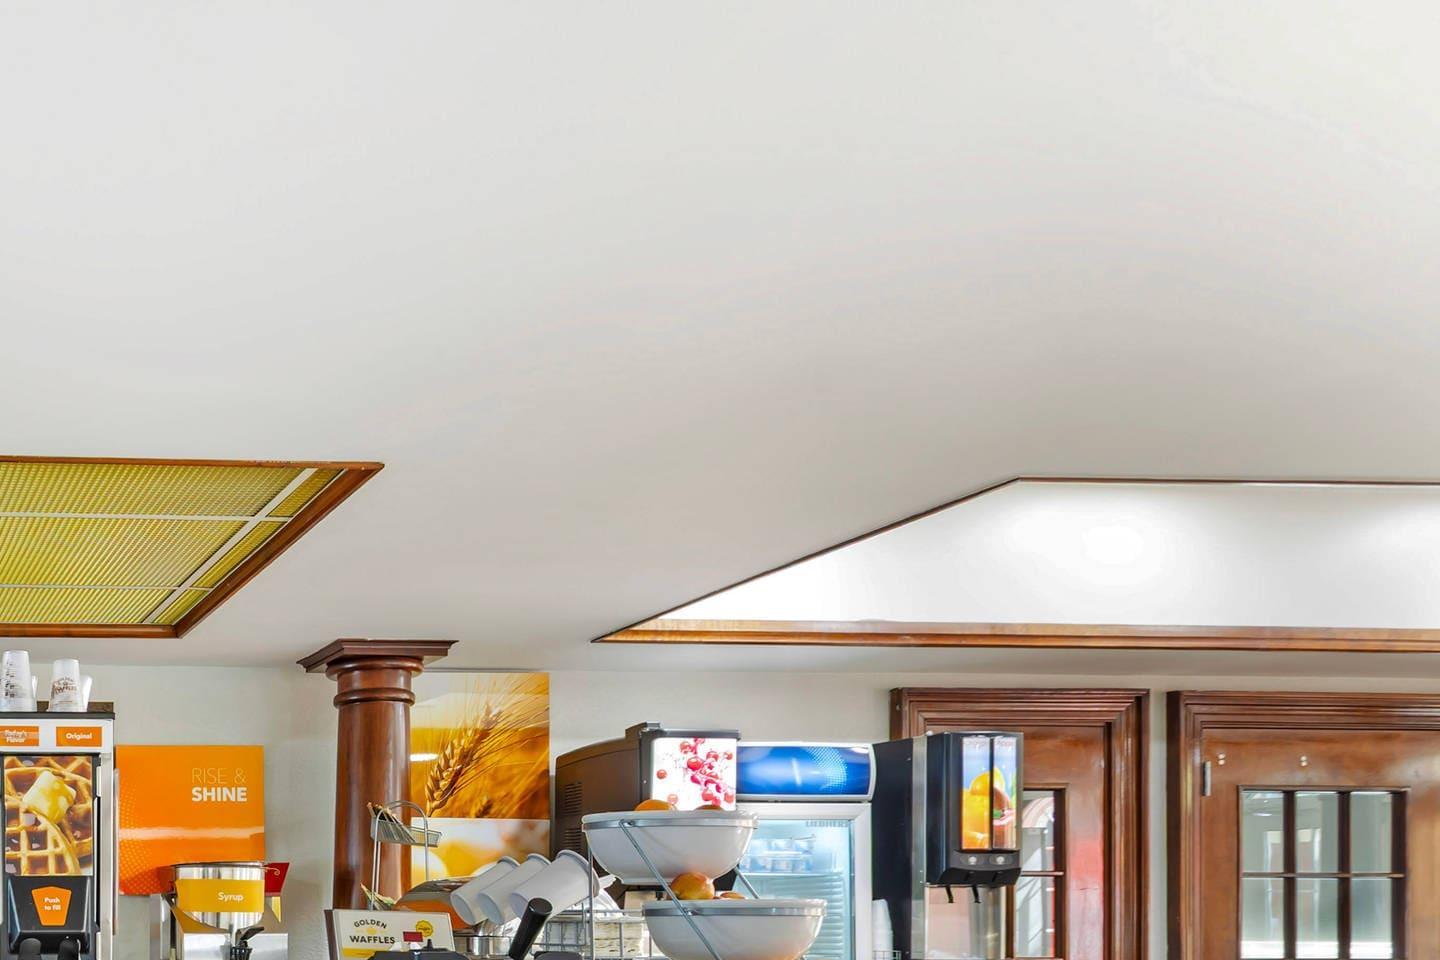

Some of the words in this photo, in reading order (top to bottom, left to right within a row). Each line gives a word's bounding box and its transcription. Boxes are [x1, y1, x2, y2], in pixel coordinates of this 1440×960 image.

[65, 732, 92, 741] Original
[191, 767, 228, 784] RISE
[234, 767, 246, 784] &
[191, 786, 248, 802] SHINE
[217, 891, 244, 902] Syrup
[353, 919, 387, 929] GOLDEN
[349, 935, 395, 944] WAFFLES
